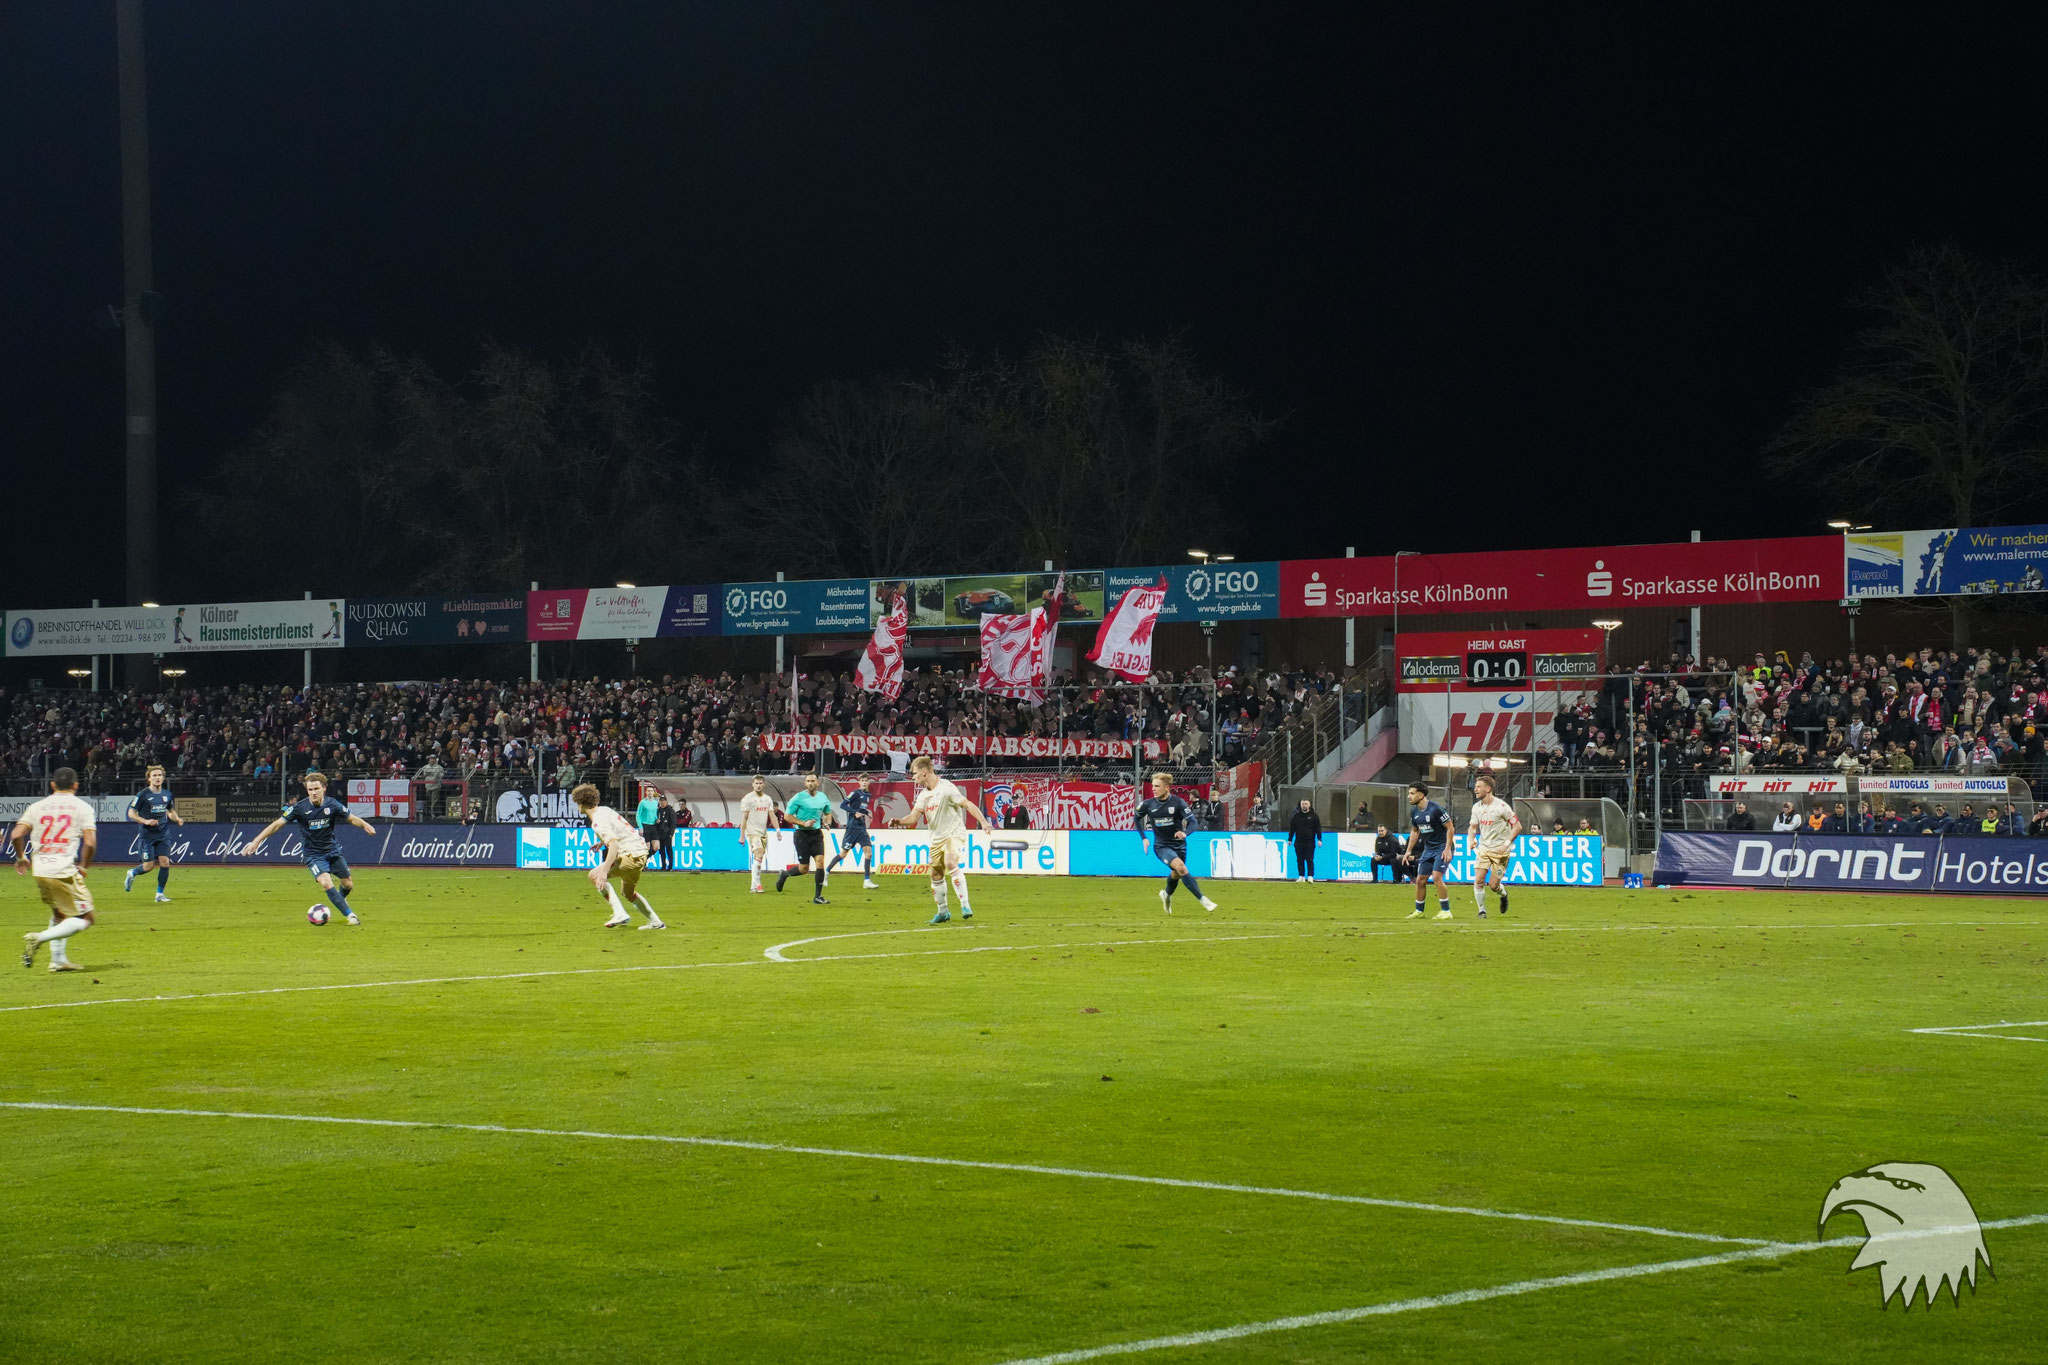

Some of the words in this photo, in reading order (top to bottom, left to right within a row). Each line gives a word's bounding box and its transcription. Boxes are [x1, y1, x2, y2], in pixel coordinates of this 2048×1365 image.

[1970, 533, 1997, 547] Wir
[1109, 575, 1153, 586] Motorsägen
[1215, 570, 1259, 593] FGO
[1851, 569, 1889, 581] Bernd
[1622, 575, 1718, 600] Sparkasse
[1724, 571, 1821, 593] KölnBonn
[1851, 583, 1900, 596] Lanius
[826, 587, 866, 598] Mähroboter
[1335, 586, 1420, 609] Sparkasse
[1424, 583, 1508, 603] KölnBonn
[442, 598, 523, 614] #Lieblingsmakler
[750, 589, 787, 610] FGO
[820, 601, 866, 611] Rasentrimmer
[200, 606, 240, 624] Kölner
[349, 602, 427, 622] RUDKOWSKI
[1198, 602, 1262, 615] www.fgo-gmbh.de
[1847, 607, 1861, 616] WC
[38, 620, 122, 633] BRENNSTOFFHANDEL
[124, 619, 145, 631] WILLI
[146, 618, 166, 630] DICK
[736, 617, 790, 630] www.fgo-gmbh.de
[815, 615, 866, 627] Laubblasgeräte
[200, 622, 314, 642] Hausmeisterdienst
[491, 625, 510, 633] HOME
[1203, 627, 1215, 635] WC
[111, 634, 133, 644] 02234
[138, 633, 152, 643] 986
[153, 632, 167, 642] 299
[1467, 640, 1495, 651] HEIM
[1499, 639, 1527, 650] GAST
[1403, 660, 1460, 676] Kaloderma
[1535, 657, 1597, 675] Kaloderma
[1439, 711, 1554, 751] HIT
[766, 733, 979, 756] VERBANDSSTRAFEN
[986, 737, 1134, 759] ABSCHAFFEN
[1718, 781, 1748, 792] HIT
[1762, 781, 1792, 792] HIT
[1808, 781, 1838, 792] HIT
[1859, 779, 1888, 791] junited
[1889, 779, 1930, 790] AUTOGLAS
[1933, 779, 1963, 791] junited
[1964, 780, 2007, 790] AUTOGLAS
[99, 801, 120, 813] DICK
[40, 814, 72, 845] 22
[401, 838, 495, 859] dorint.com
[311, 864, 320, 876] 11
[879, 864, 906, 874] WEST
[1939, 851, 2048, 885] Hotels
